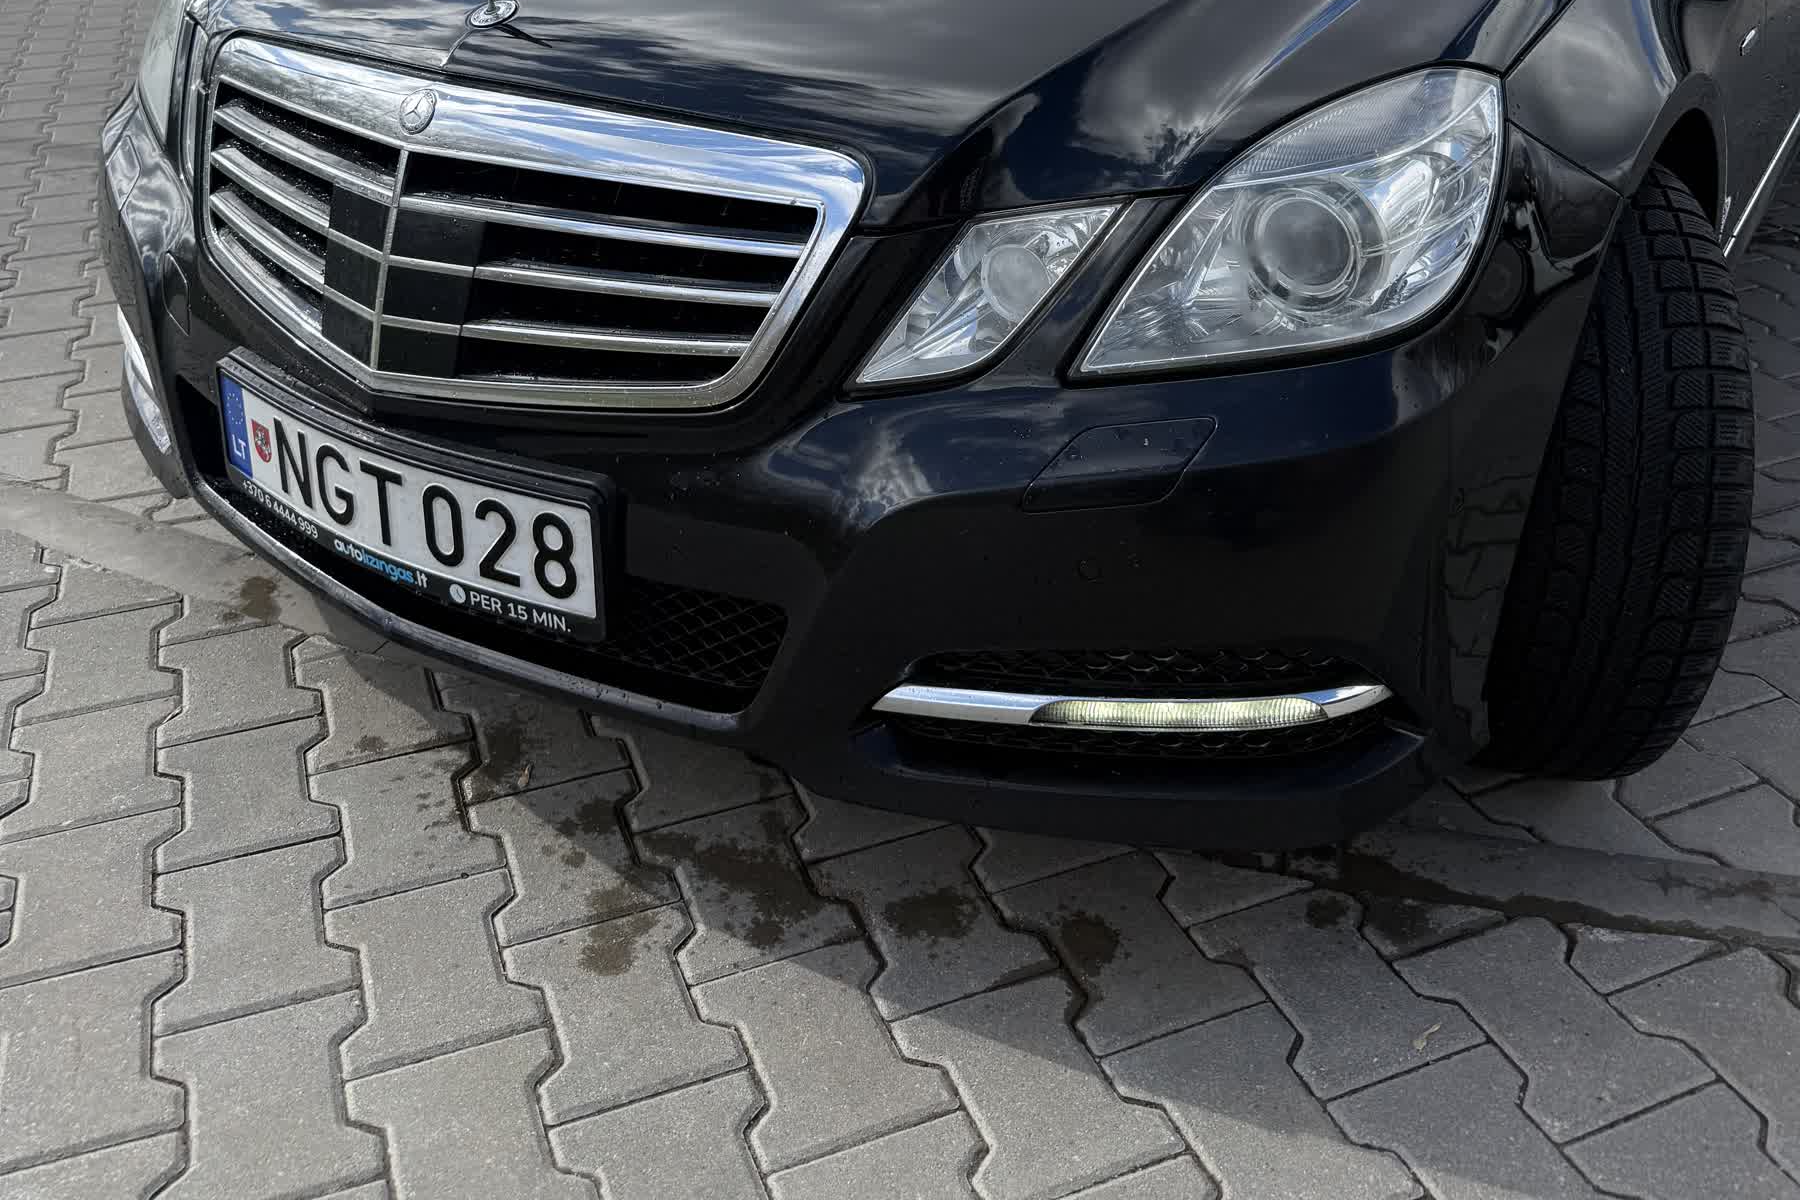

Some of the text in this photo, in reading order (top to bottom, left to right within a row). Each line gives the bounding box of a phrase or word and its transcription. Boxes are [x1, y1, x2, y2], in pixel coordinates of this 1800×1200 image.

[231, 433, 247, 461] LT
[265, 493, 272, 508] 6
[297, 516, 319, 539] 999
[273, 416, 578, 600] NGT 028
[333, 538, 428, 589] autolizingas.lt
[469, 590, 572, 633] PER 15 MIN.
